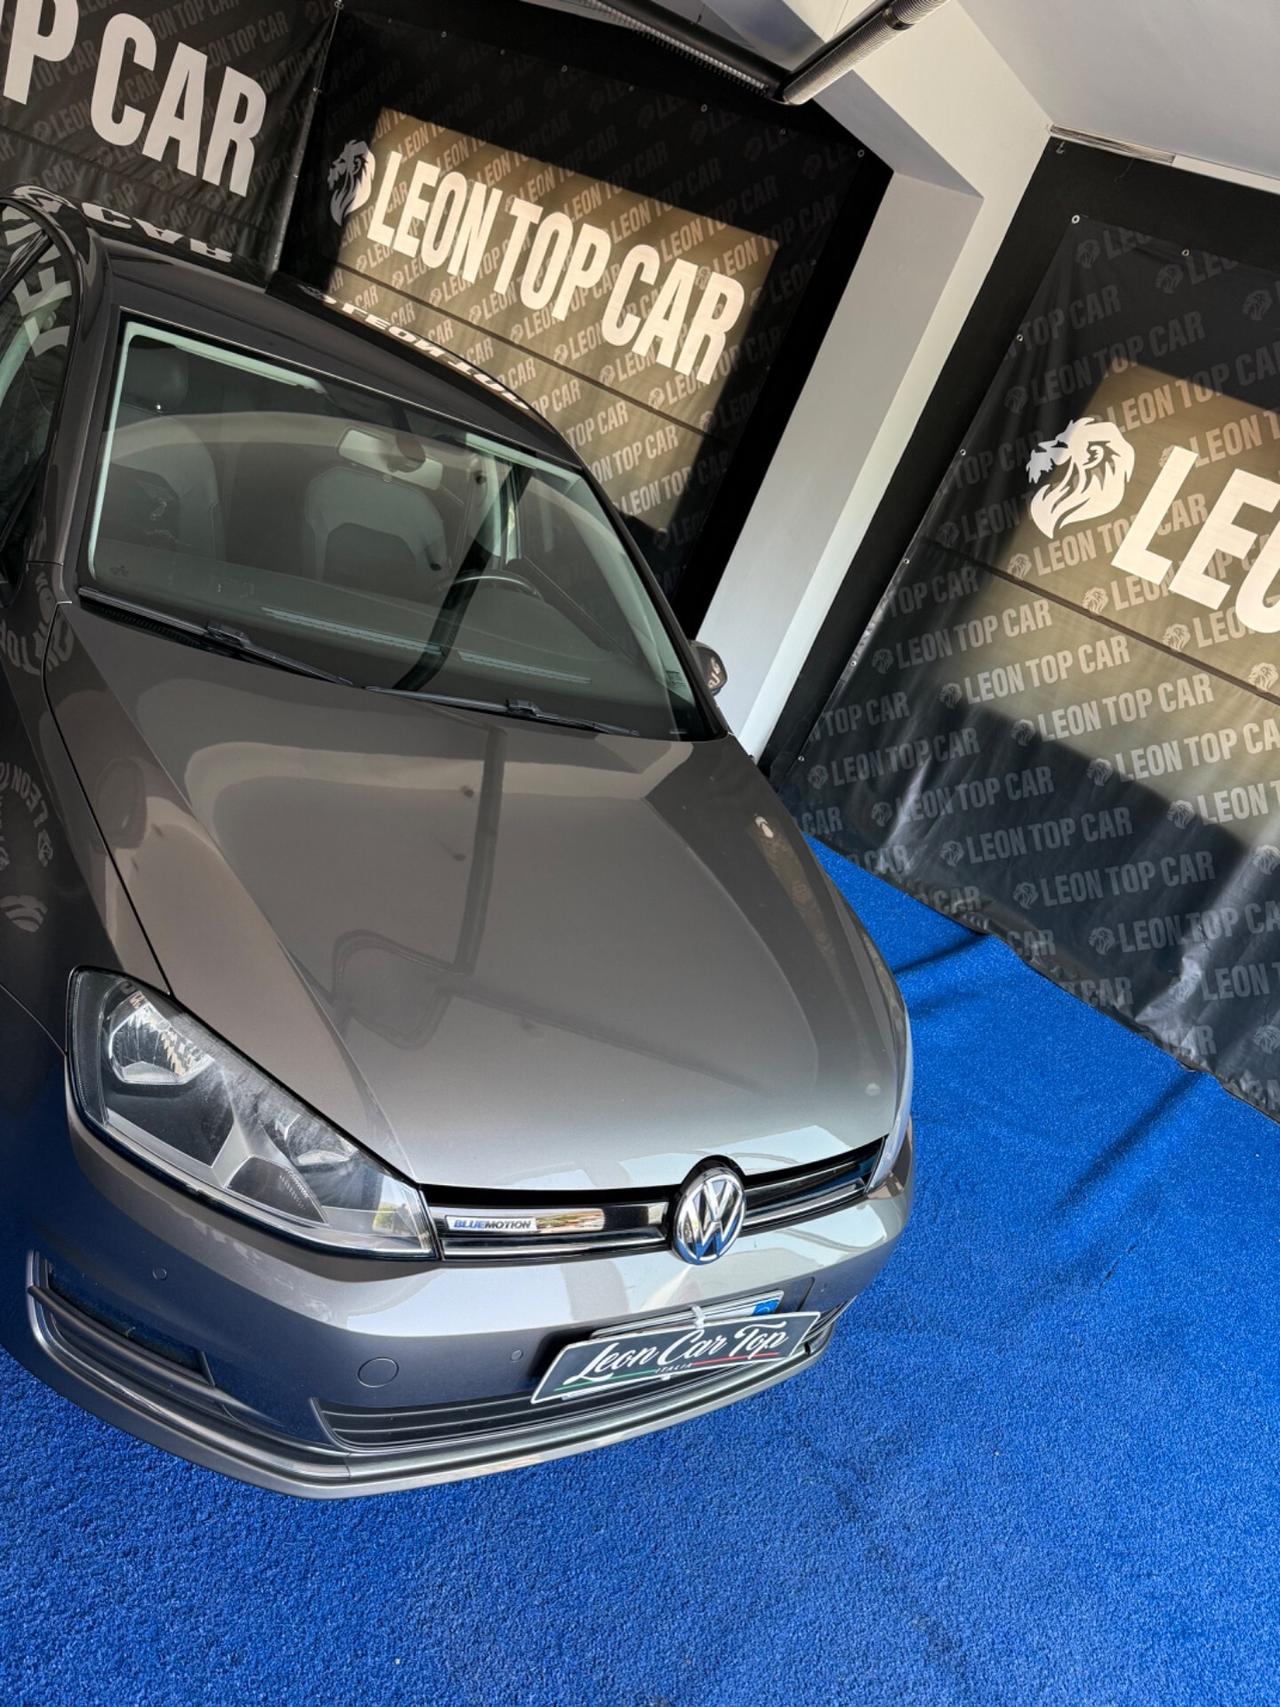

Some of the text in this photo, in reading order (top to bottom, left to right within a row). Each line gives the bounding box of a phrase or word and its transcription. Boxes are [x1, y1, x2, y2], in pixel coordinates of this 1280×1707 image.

[227, 24, 257, 57] TOP
[258, 10, 290, 43] CAR
[64, 39, 100, 76] CAR
[0, 0, 267, 198] P CAR
[123, 69, 162, 103] CAR
[41, 159, 78, 195] CAR
[611, 201, 651, 244] LEON
[660, 217, 704, 263] LEON
[367, 243, 394, 269] LEO
[367, 151, 745, 385] LEON TOP CAR
[354, 284, 379, 311] CAR
[390, 303, 416, 326] CAR
[1070, 284, 1121, 330] CAR
[428, 319, 454, 344] CAR
[466, 337, 494, 365] CAR
[508, 357, 536, 390] CAR
[1030, 356, 1093, 406] LEON
[1149, 310, 1206, 358] CAR
[551, 379, 581, 412] CAR
[1106, 384, 1175, 434] LEON
[1173, 363, 1229, 410] TOP
[565, 401, 629, 451] TOP CAR
[1188, 414, 1263, 468] LEON
[591, 424, 679, 485] ON TOP CAR
[620, 481, 661, 515] LEON
[1033, 530, 1097, 576] LEON
[1111, 446, 1280, 634] LEO
[931, 566, 979, 604] CAR
[896, 599, 1052, 670] LEON TOP CAR
[963, 635, 1131, 705] LEON TOP CAR
[822, 703, 863, 738] TOP
[866, 691, 911, 727] CAR
[1037, 672, 1215, 741] LEON TOP CAR
[830, 727, 981, 787] LEON TOP CAR
[1114, 740, 1184, 783] LEON
[1183, 727, 1238, 768] TOP
[953, 776, 1000, 811] TOP
[1004, 765, 1055, 801] CAR
[1196, 783, 1270, 826] LEON
[801, 805, 843, 836] CAR
[965, 806, 1134, 865] LEON TOP CAR
[933, 884, 981, 915] CAR
[1039, 850, 1216, 907] LEON TOP CAR
[1117, 914, 1184, 954] LEON
[1184, 906, 1240, 946] TOP
[1202, 962, 1272, 1002] LEON
[453, 1217, 532, 1231] BLUEMOTION
[563, 1320, 789, 1386] Leon Car Top
